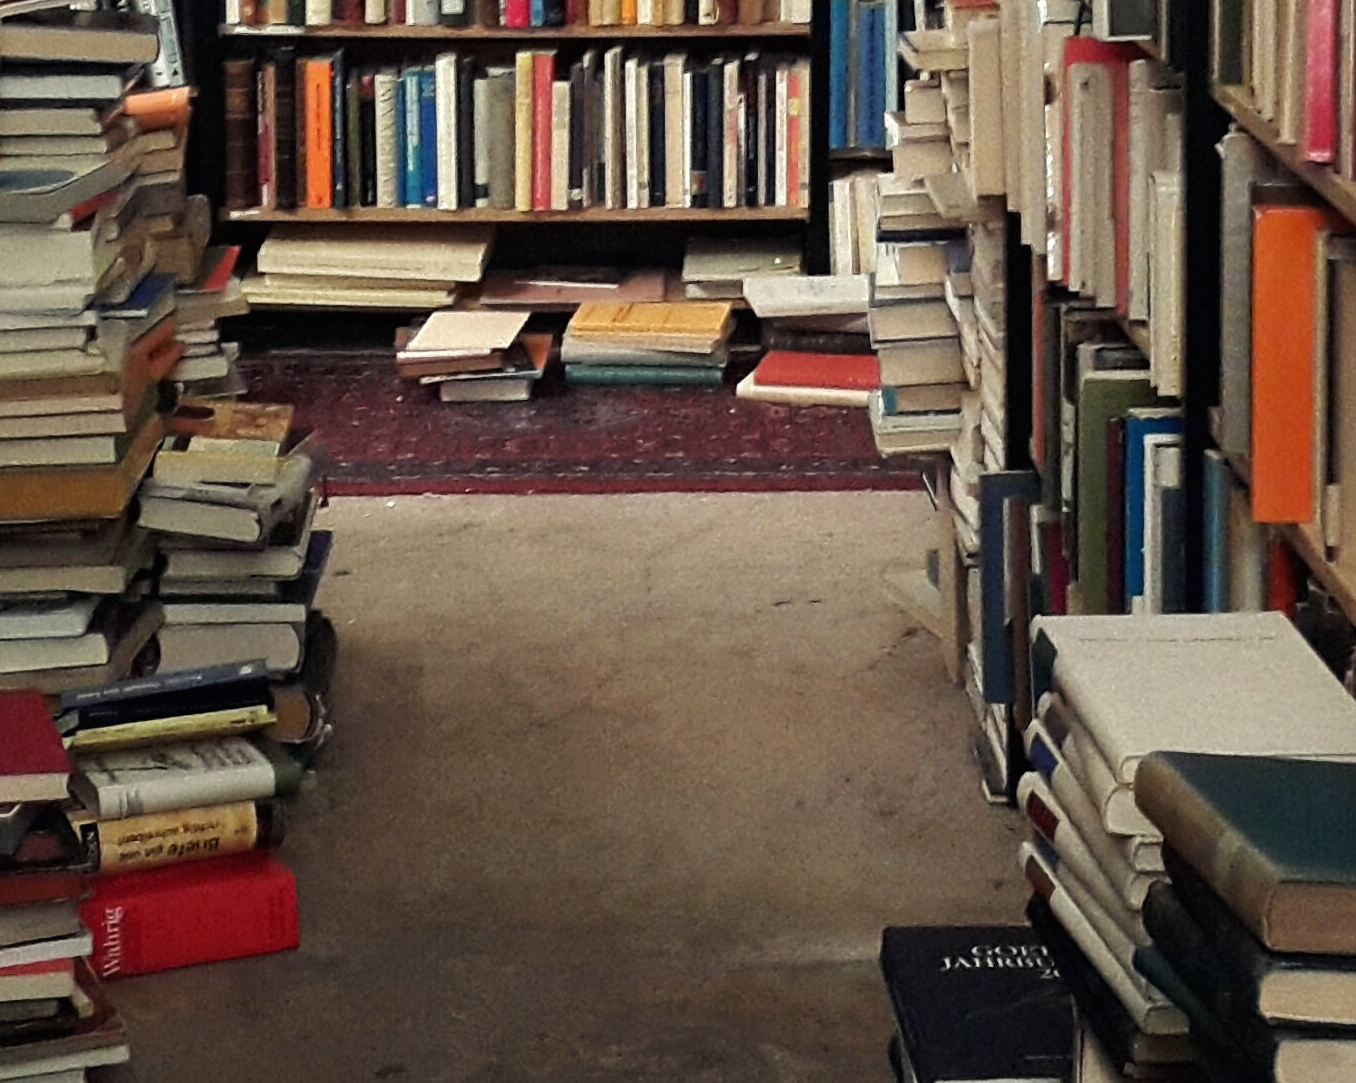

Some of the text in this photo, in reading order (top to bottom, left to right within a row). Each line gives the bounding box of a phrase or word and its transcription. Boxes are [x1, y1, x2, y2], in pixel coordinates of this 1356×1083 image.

[181, 821, 221, 838] richtig
[119, 848, 143, 864] und
[166, 836, 221, 859] Briefe
[100, 904, 124, 978] Wahrig
[940, 957, 1055, 972] JAHRBU
